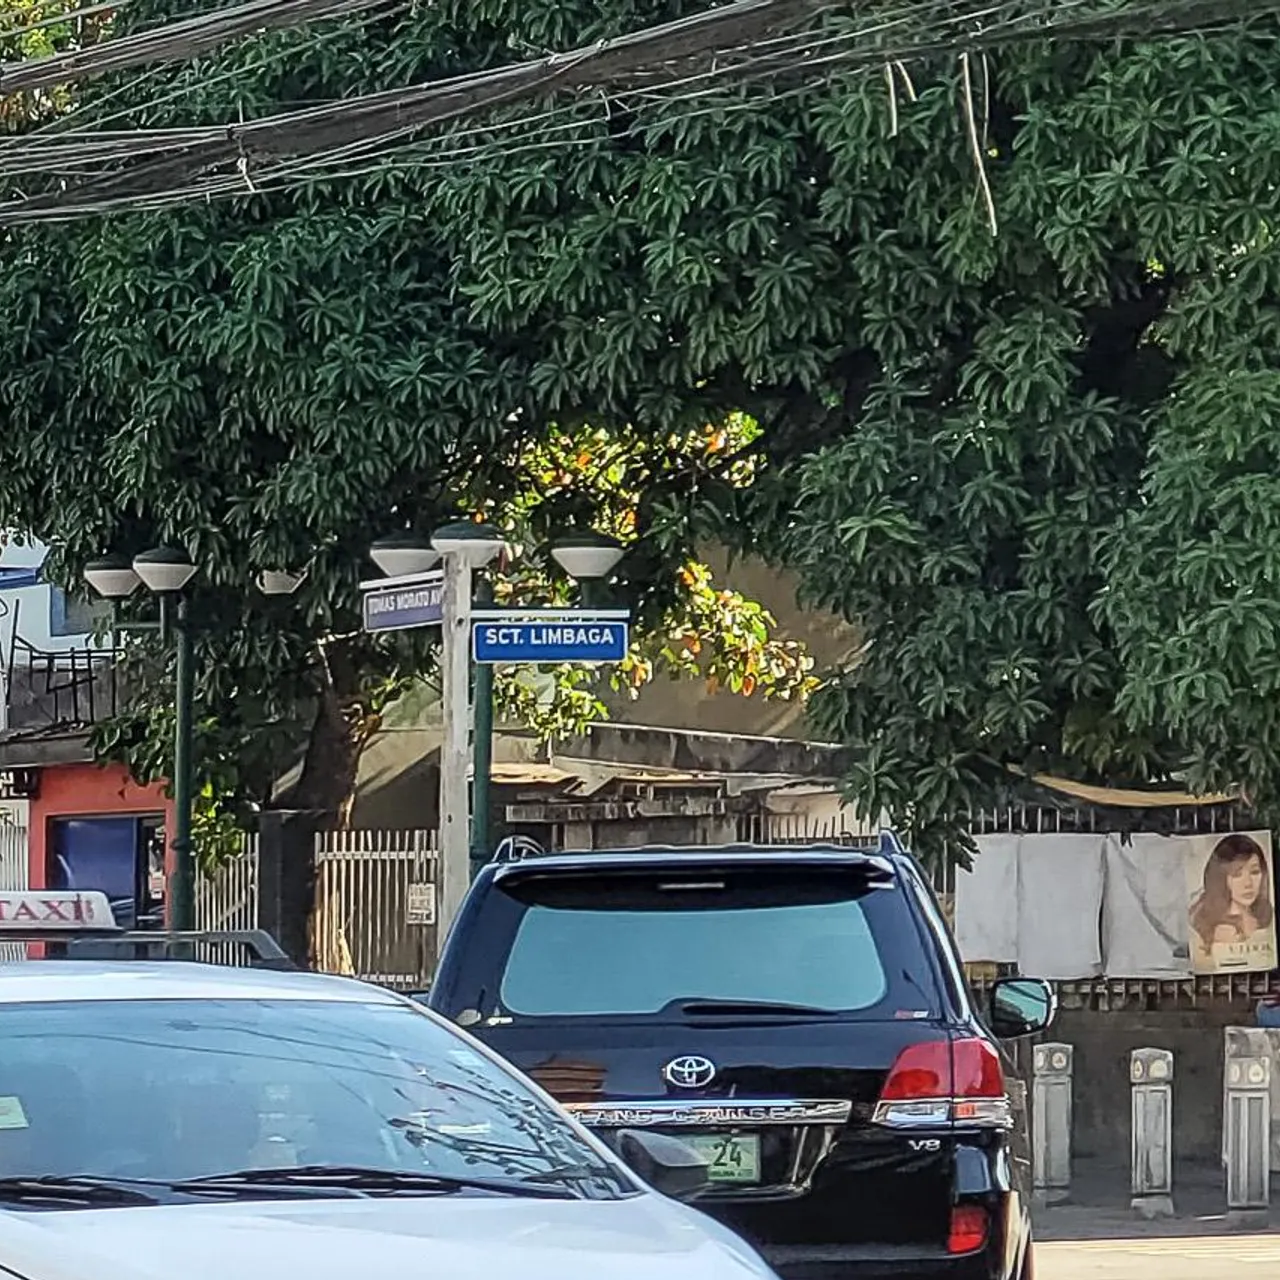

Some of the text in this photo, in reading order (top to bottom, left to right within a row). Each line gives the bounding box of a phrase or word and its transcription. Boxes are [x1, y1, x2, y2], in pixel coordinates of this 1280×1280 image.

[485, 628, 614, 645] SCT. LIMBAGA
[712, 1141, 742, 1167] 24
[908, 1140, 941, 1151] V8
